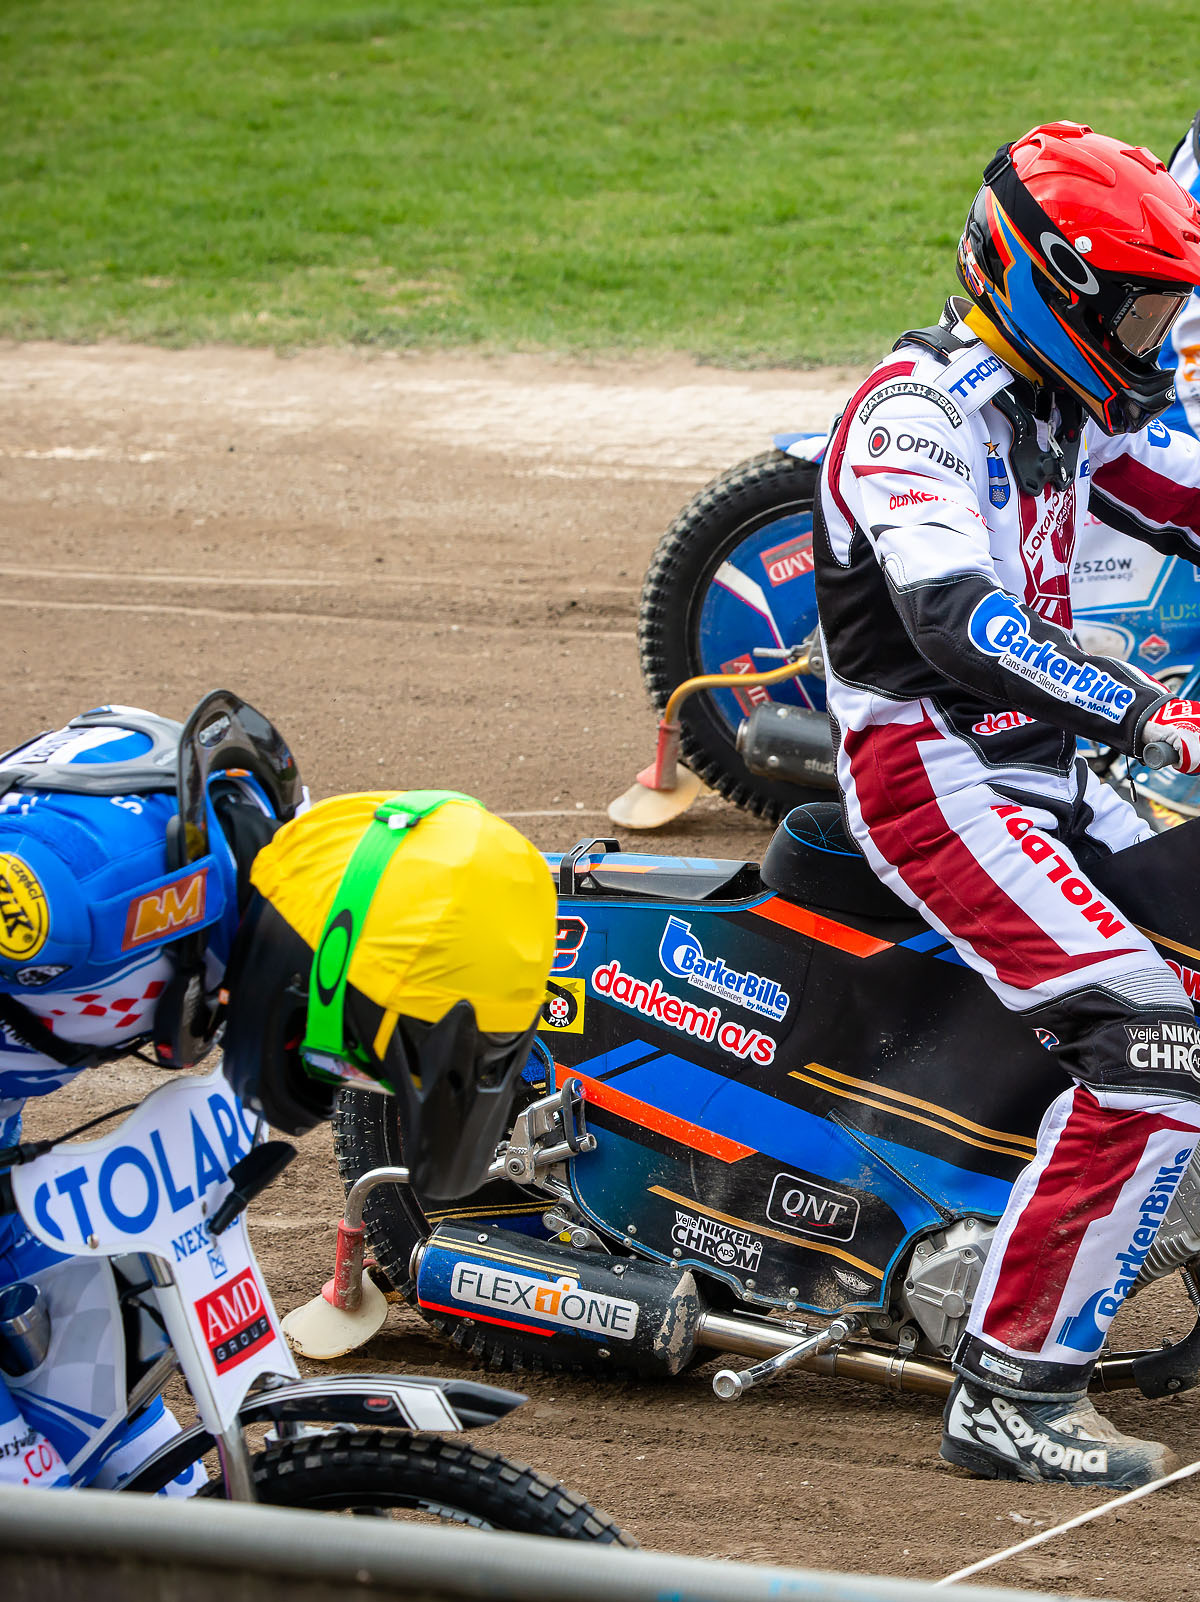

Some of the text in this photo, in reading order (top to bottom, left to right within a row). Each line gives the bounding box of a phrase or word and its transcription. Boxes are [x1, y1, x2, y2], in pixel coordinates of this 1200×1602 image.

[896, 433, 971, 481] OPTIBET
[993, 619, 1133, 709] BarkerBille
[1002, 654, 1070, 699] Fans and Silencers
[1075, 696, 1121, 720] by Moldow
[681, 947, 788, 1011] BarkerBille
[690, 974, 742, 1004] Fans and Silencers
[548, 1016, 570, 1027] PZM
[595, 963, 774, 1062] dankemi a/s
[746, 1000, 783, 1020] by Moldow
[1128, 1027, 1160, 1043] Vejle
[781, 1189, 849, 1225] QNT
[672, 1224, 760, 1271] CHROM
[676, 1212, 762, 1252] Vejle NIKKEL &
[717, 1246, 734, 1258] ApS
[1097, 1148, 1193, 1318] BarkerBille
[207, 1277, 261, 1343] AMD
[216, 1318, 269, 1361] GROUP
[992, 1397, 1108, 1473] daytona
